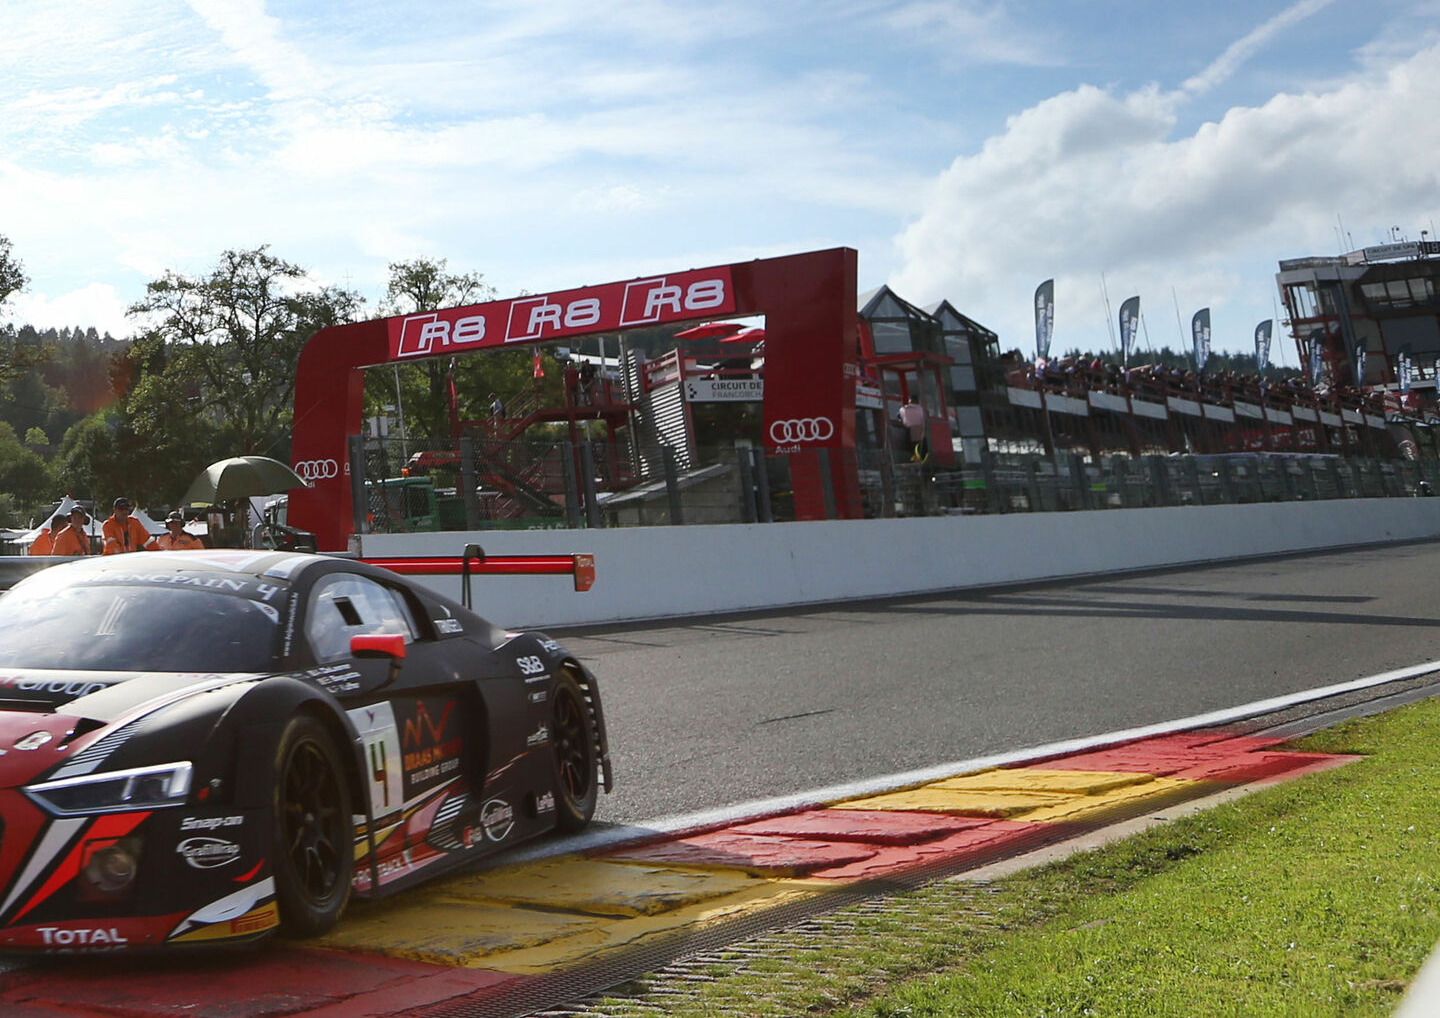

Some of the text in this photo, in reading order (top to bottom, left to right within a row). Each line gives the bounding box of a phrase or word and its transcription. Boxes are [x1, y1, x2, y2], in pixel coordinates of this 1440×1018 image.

[643, 279, 725, 317] R8
[526, 298, 601, 334] R8
[417, 315, 486, 350] R8
[711, 382, 762, 391] CIRCUIT DE
[775, 444, 801, 454] Audi
[256, 584, 279, 601] 4
[516, 655, 545, 675] S&B
[369, 740, 389, 808] 4
[180, 815, 244, 830] Snap-on
[35, 927, 128, 944] TOTAL
